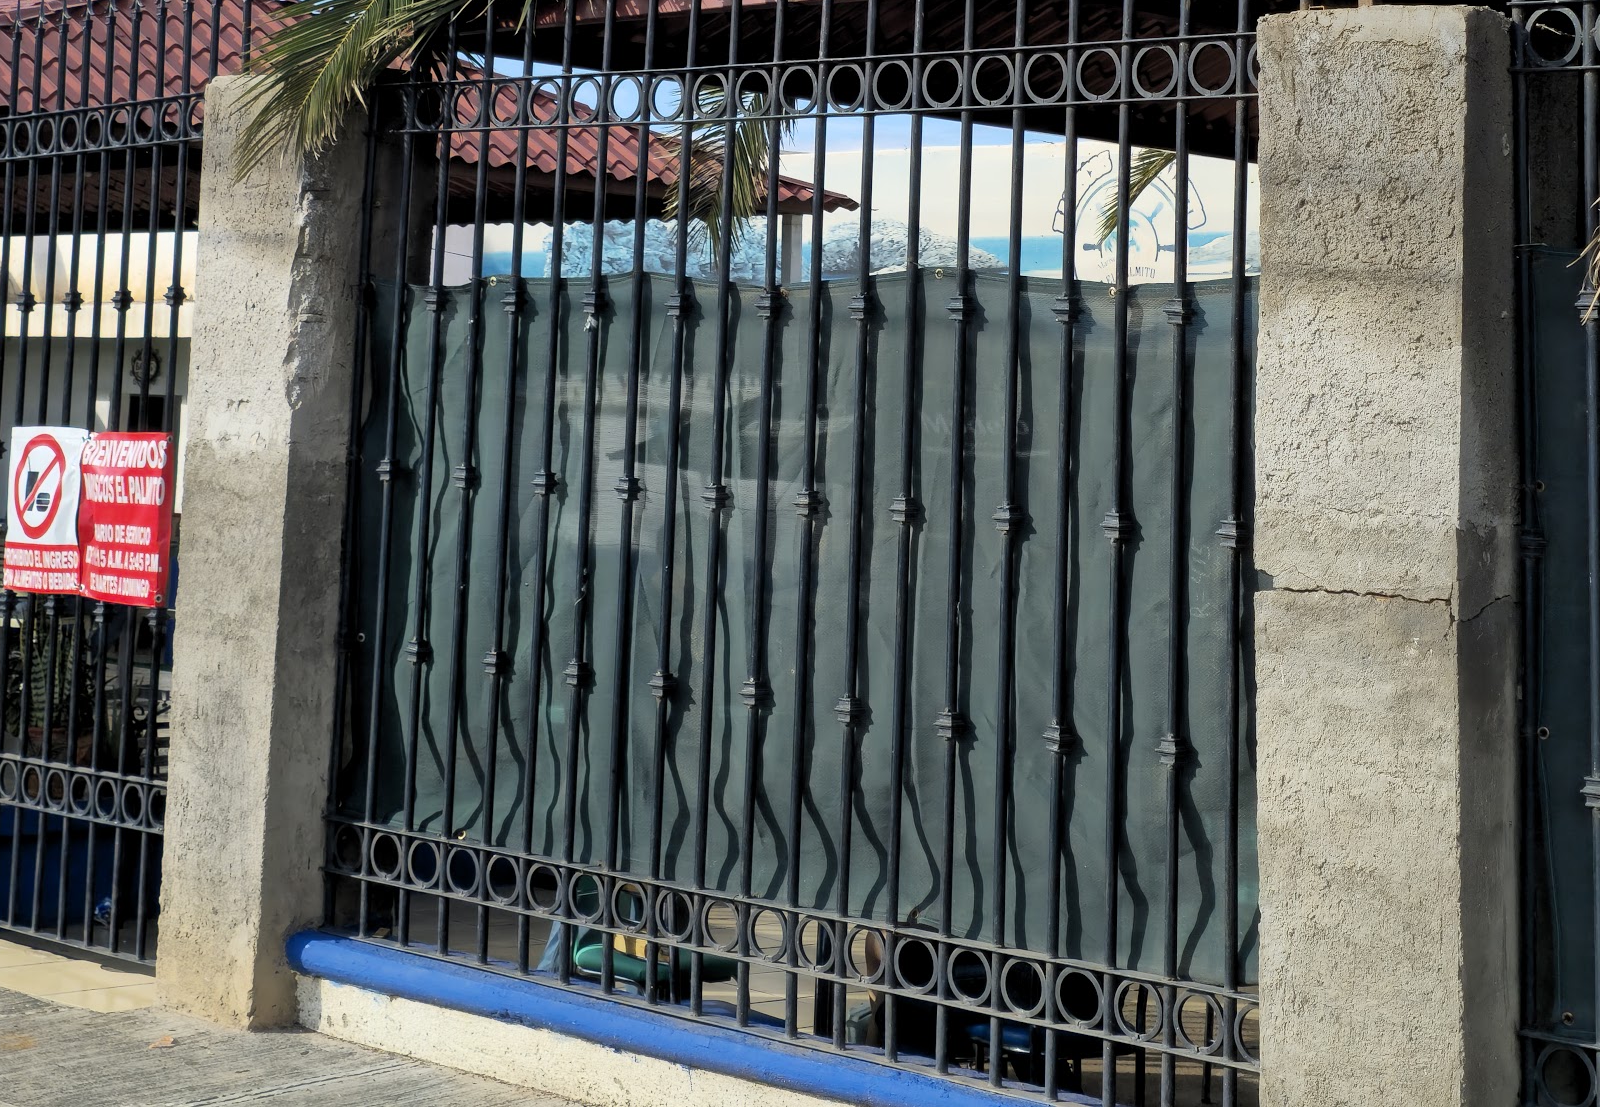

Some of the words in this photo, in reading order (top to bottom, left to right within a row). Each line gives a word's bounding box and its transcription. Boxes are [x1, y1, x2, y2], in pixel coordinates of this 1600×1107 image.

[82, 440, 167, 469] BIENVENIDOS
[116, 476, 128, 503] EL
[128, 476, 165, 506] PALMITO
[115, 525, 125, 543] DE
[125, 525, 151, 546] SERVICIO
[34, 550, 43, 567] EL
[43, 551, 79, 569] INGRESO
[107, 550, 123, 569] A.M.
[123, 551, 129, 569] A
[129, 552, 144, 571] 5:45
[145, 553, 162, 572] P.M.
[13, 570, 42, 589] ALIMENTOS
[42, 572, 48, 590] O
[90, 572, 96, 591] DE
[96, 574, 117, 594] MARTES
[117, 577, 122, 595] A
[122, 578, 150, 598] DOMINGO
